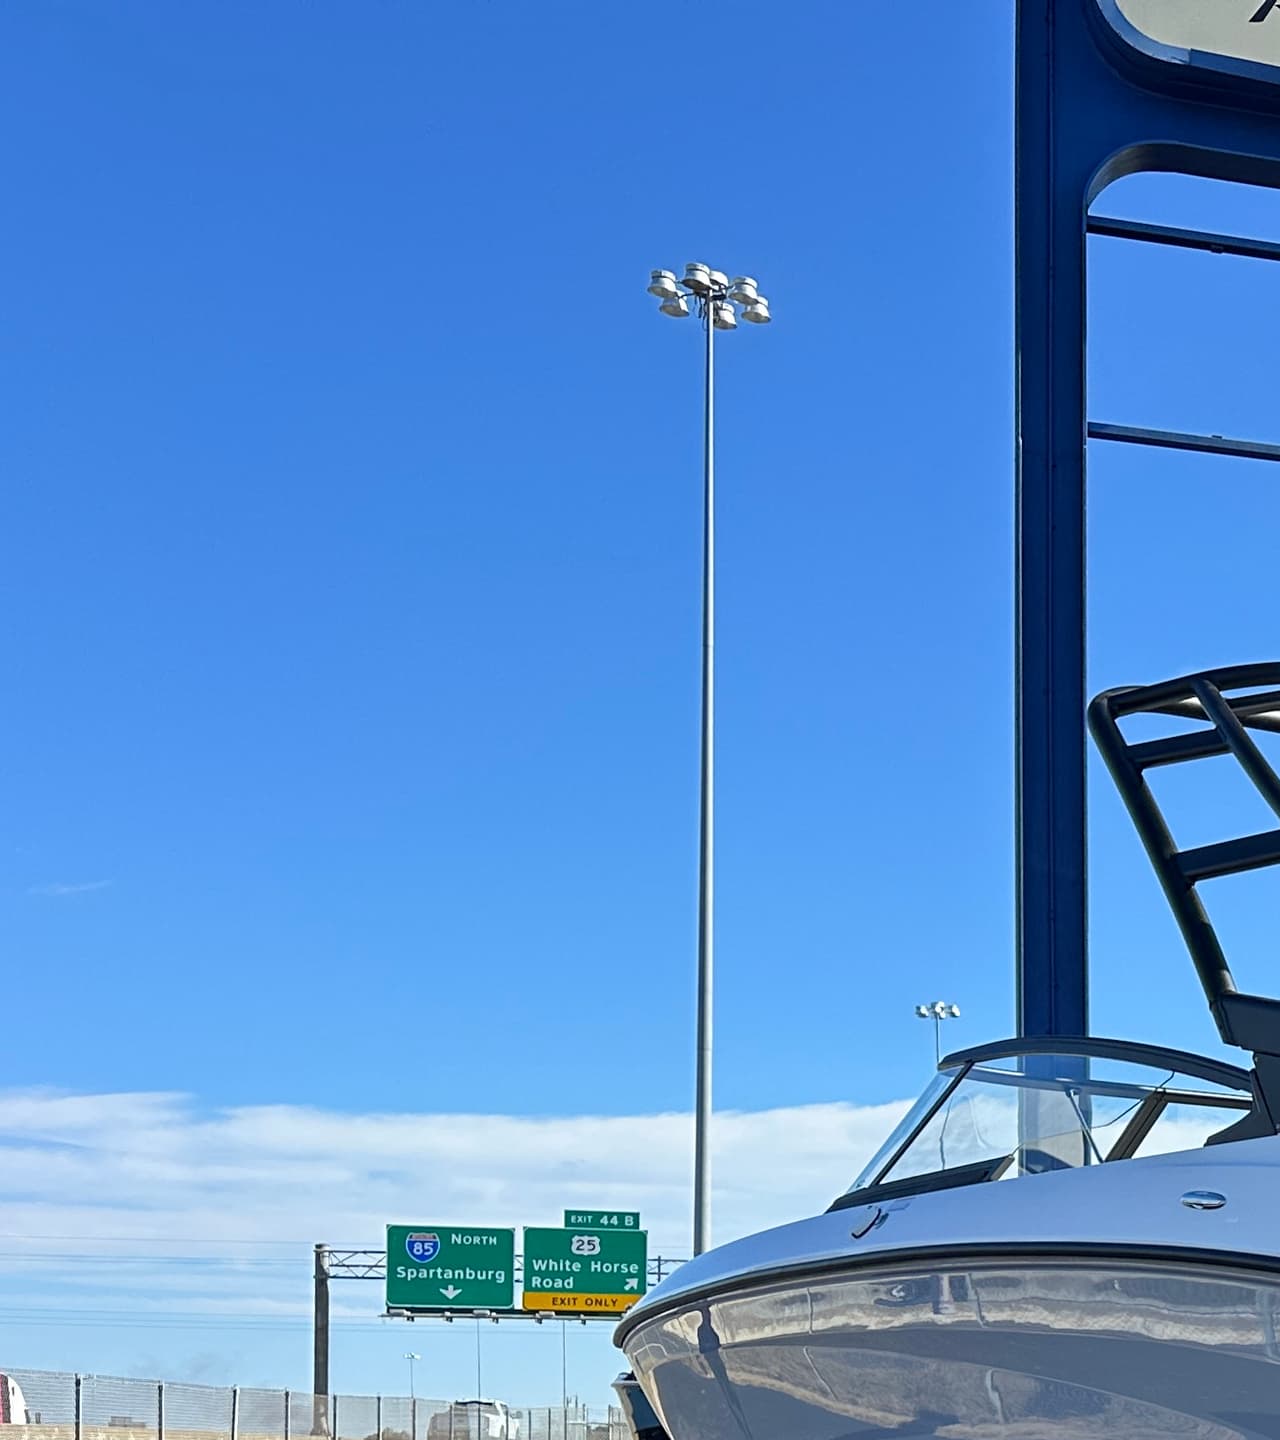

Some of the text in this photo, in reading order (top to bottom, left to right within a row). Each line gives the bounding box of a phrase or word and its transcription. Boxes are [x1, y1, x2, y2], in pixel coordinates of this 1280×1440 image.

[570, 1214, 634, 1226] EXIT 44 B
[412, 1233, 497, 1255] 85 NORTH
[575, 1239, 596, 1252] 25
[532, 1259, 639, 1273] White Horse
[396, 1266, 505, 1284] Spartanburg
[531, 1276, 574, 1289] Road
[552, 1297, 618, 1307] EXIT ONLY
